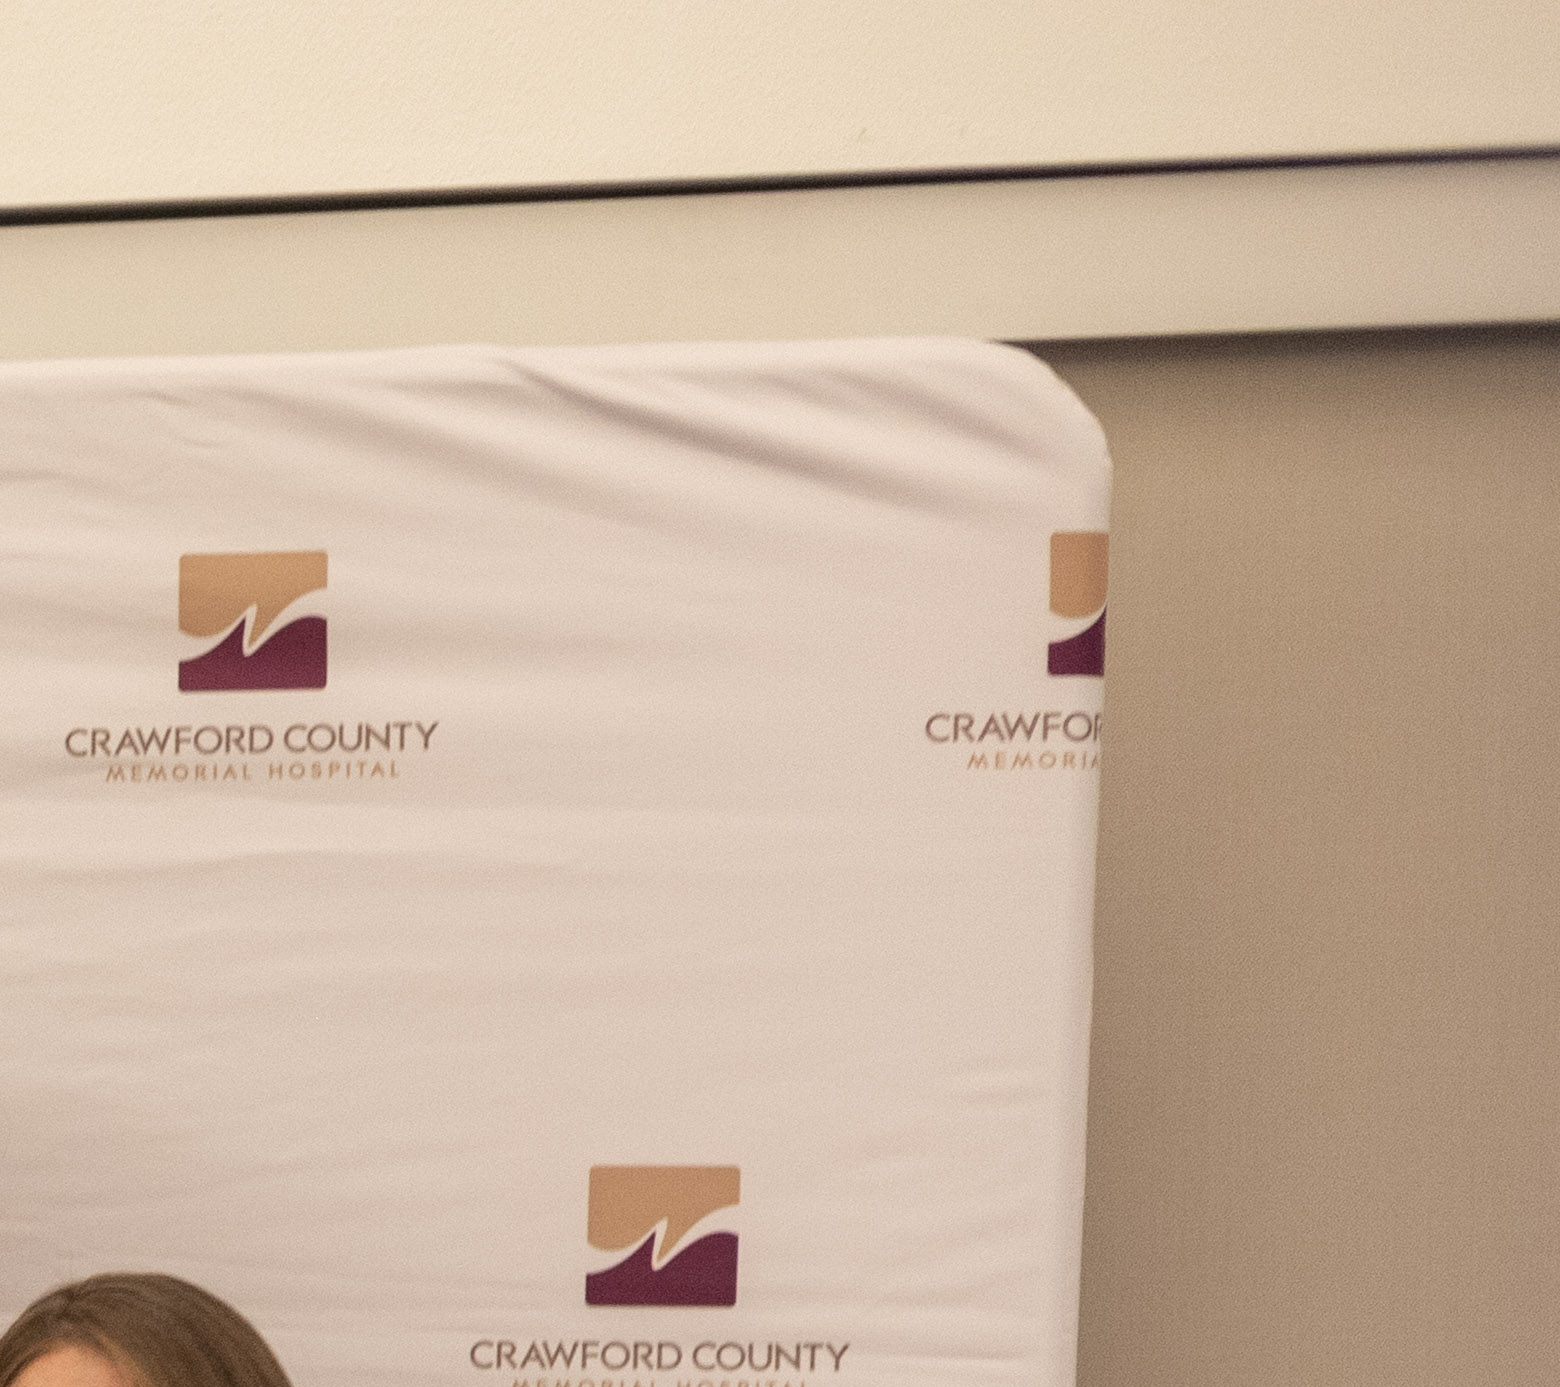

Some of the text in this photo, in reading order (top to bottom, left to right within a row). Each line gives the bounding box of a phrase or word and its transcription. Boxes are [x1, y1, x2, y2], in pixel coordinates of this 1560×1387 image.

[65, 721, 439, 758] CRAWFORD COUNTY
[106, 760, 399, 783] MEMORIAL HOSPITAL
[469, 1339, 850, 1373] CRAWFORD COUNTY
